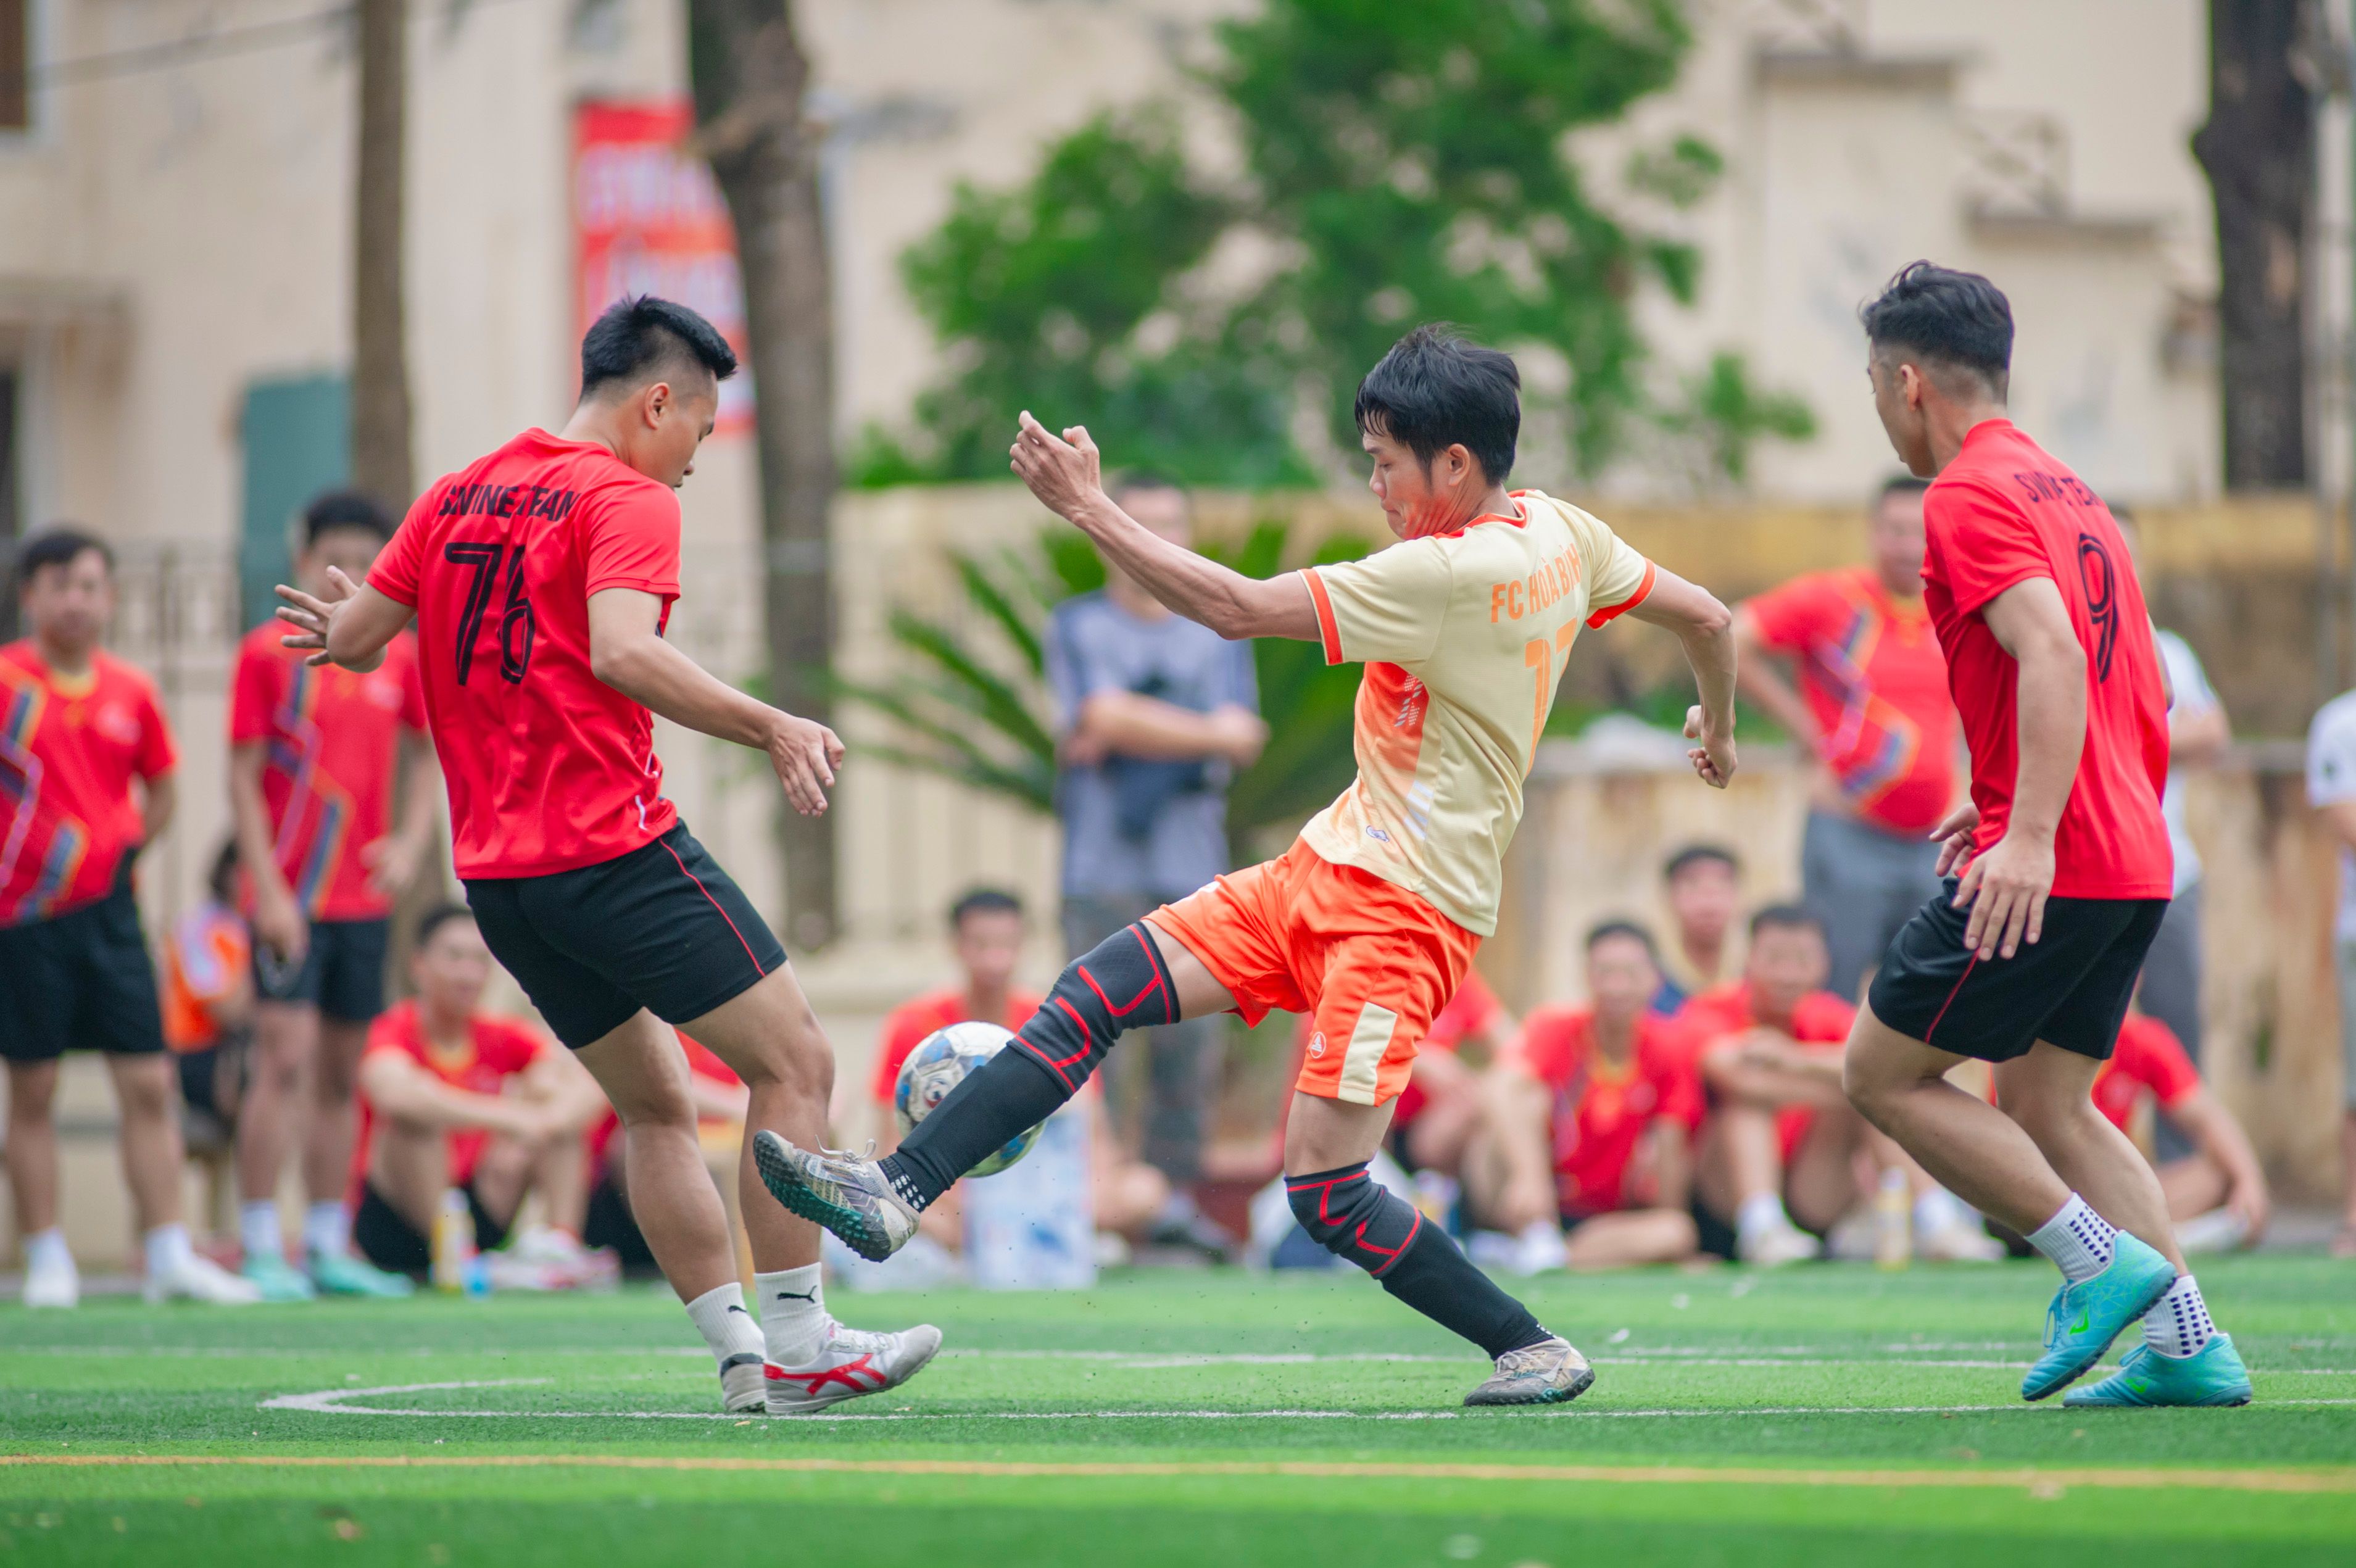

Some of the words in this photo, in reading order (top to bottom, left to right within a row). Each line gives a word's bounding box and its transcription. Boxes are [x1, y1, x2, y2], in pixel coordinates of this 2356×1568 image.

[444, 541, 536, 687] 76
[1491, 579, 1524, 623] FC
[2078, 533, 2119, 684] 9
